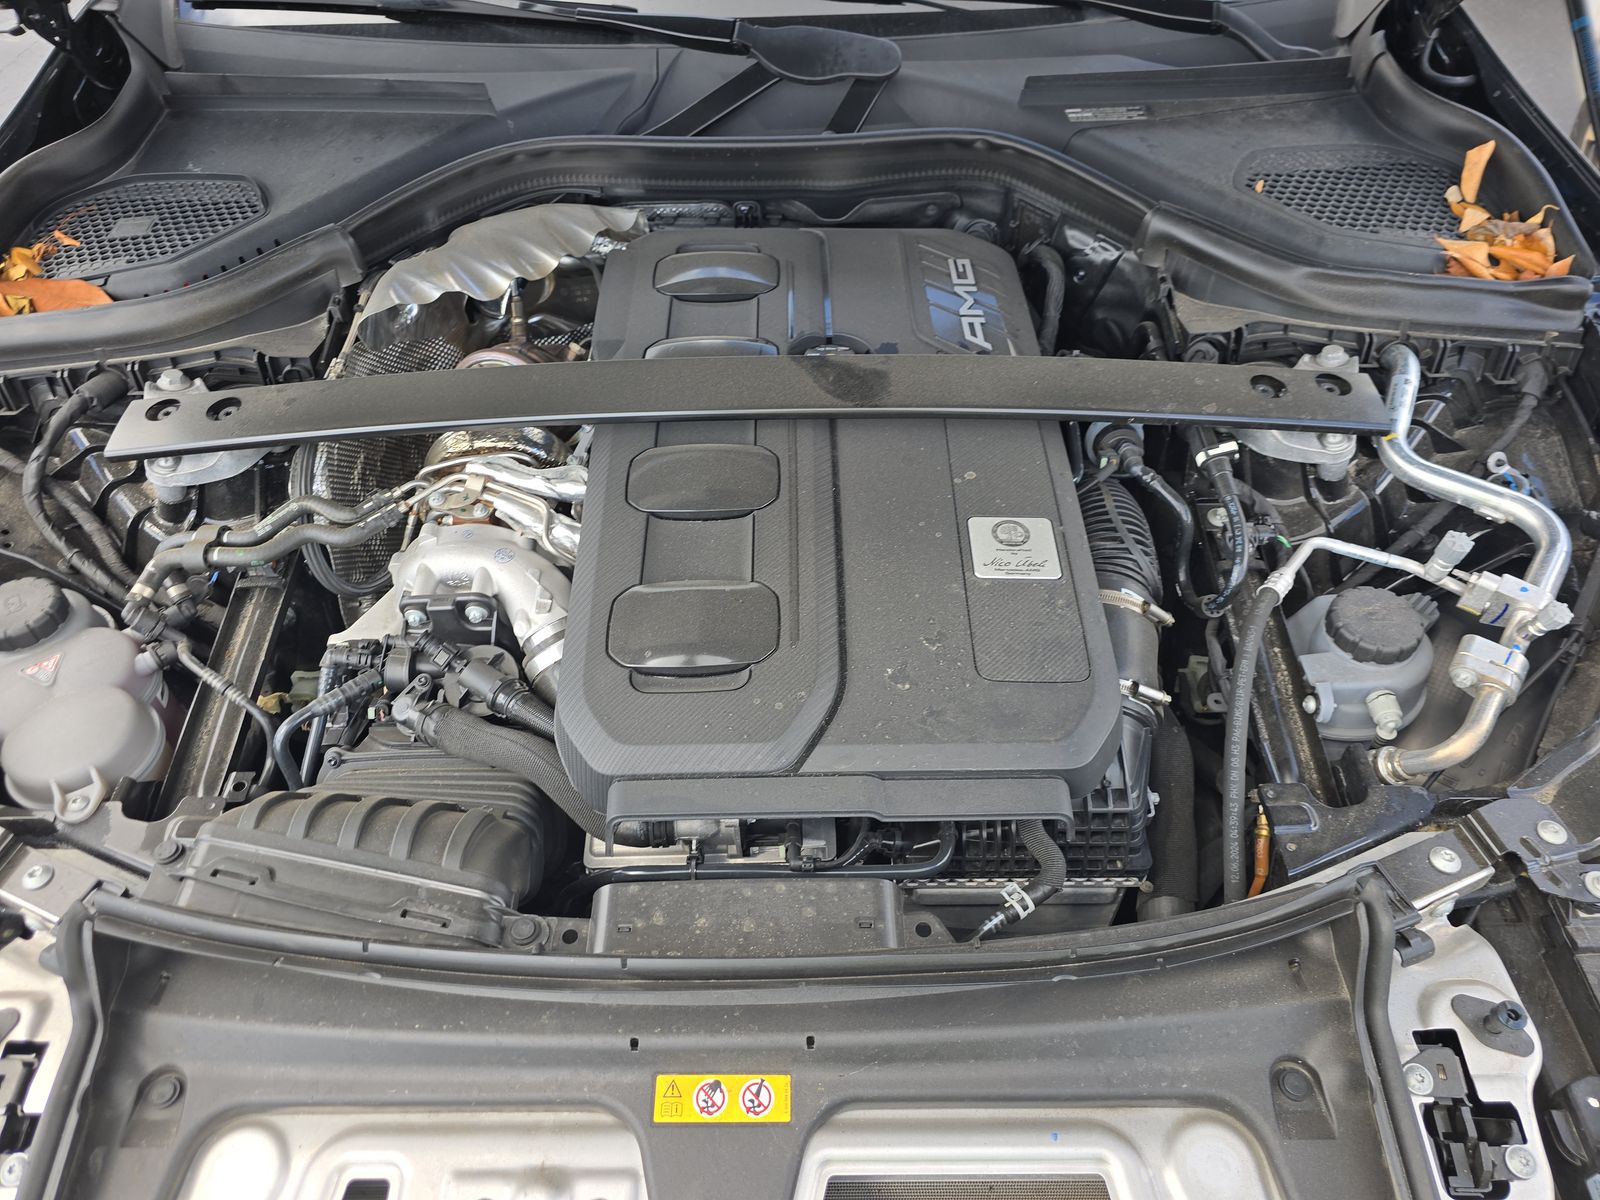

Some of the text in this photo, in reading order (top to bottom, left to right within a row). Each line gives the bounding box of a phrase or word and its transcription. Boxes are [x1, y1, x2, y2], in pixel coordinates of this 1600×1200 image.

[947, 259, 993, 351] AMG
[1229, 802, 1239, 839] 04:39:43
[1230, 841, 1240, 883] 12.06.2024
